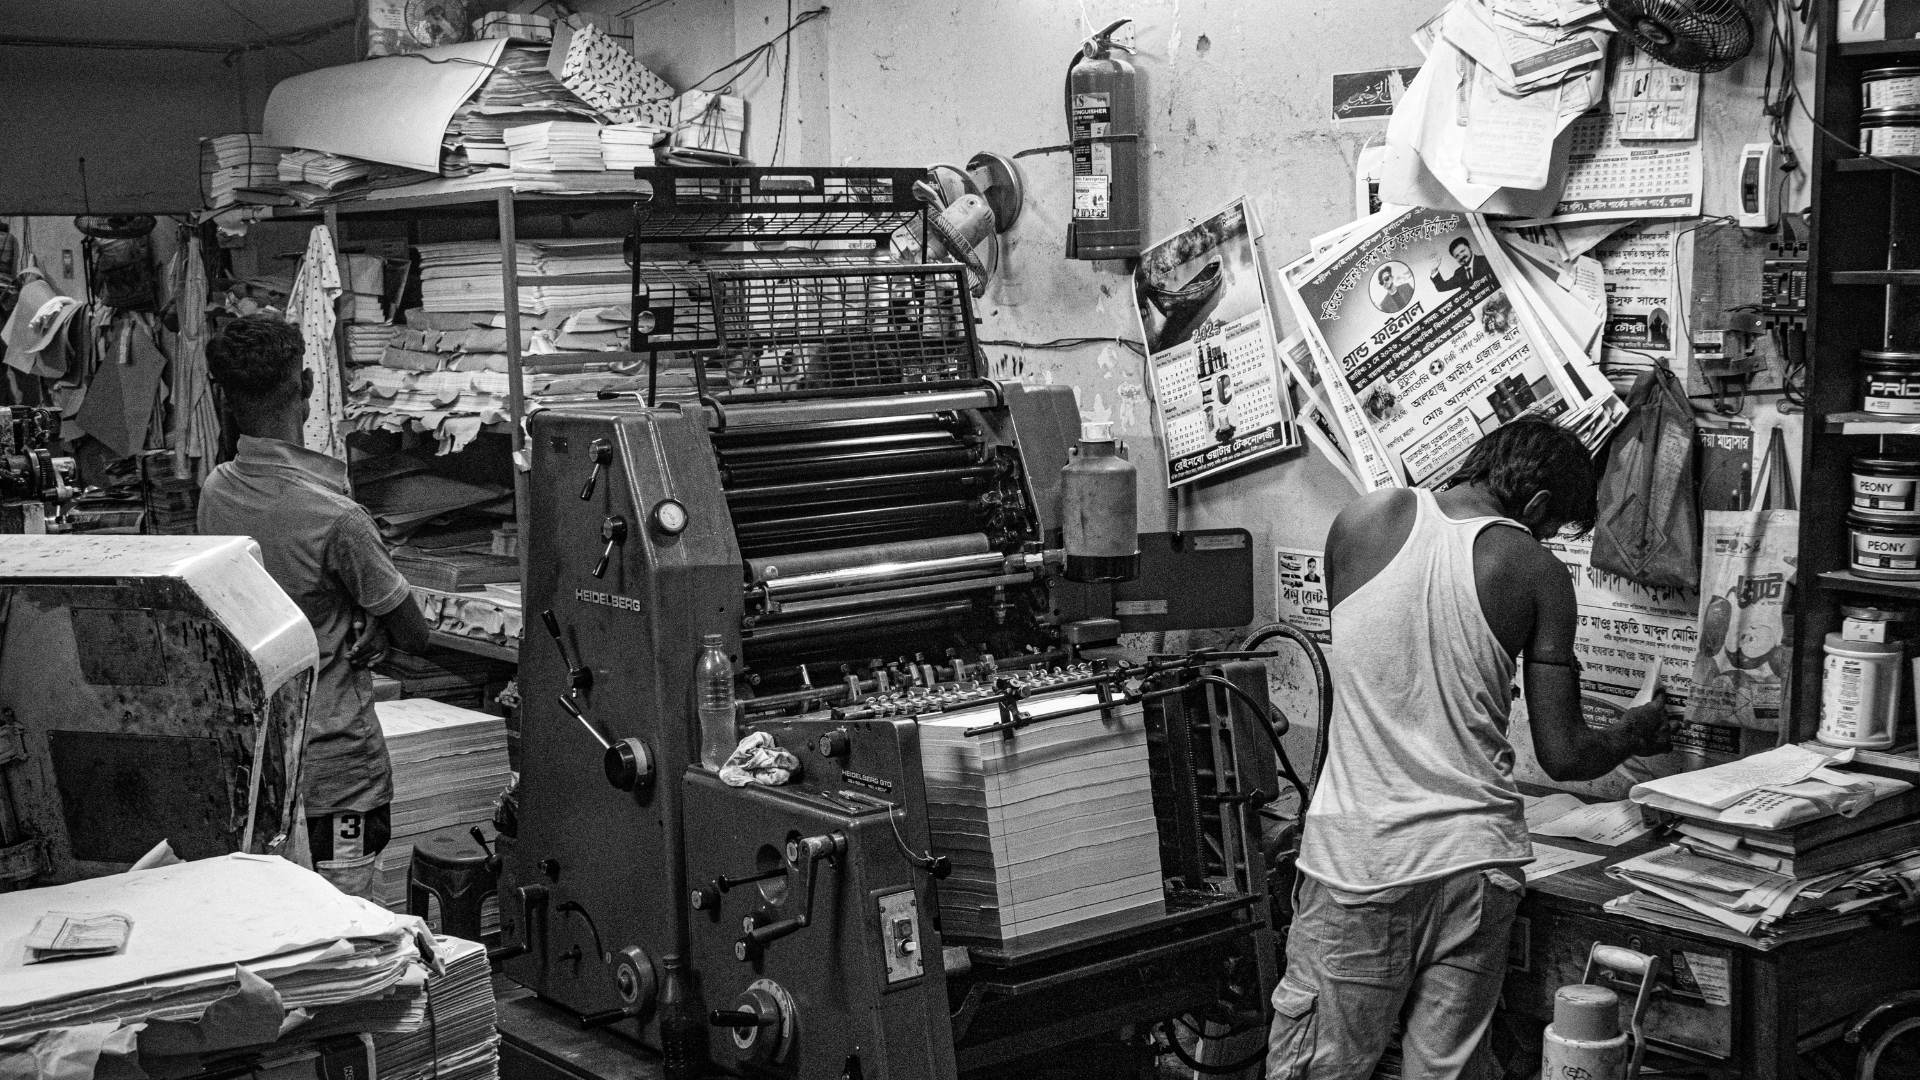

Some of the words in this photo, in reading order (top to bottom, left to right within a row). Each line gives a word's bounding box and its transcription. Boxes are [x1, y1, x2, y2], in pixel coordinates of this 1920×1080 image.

[1636, 296, 1667, 305] সাহেব
[1717, 434, 1750, 451] মাদ্রাসার
[1860, 481, 1893, 494] PEONY
[1868, 540, 1905, 553] PEONY
[576, 589, 640, 611] HEIDELBERG
[842, 770, 878, 784] HEIDELBERG
[340, 814, 361, 840] 3
